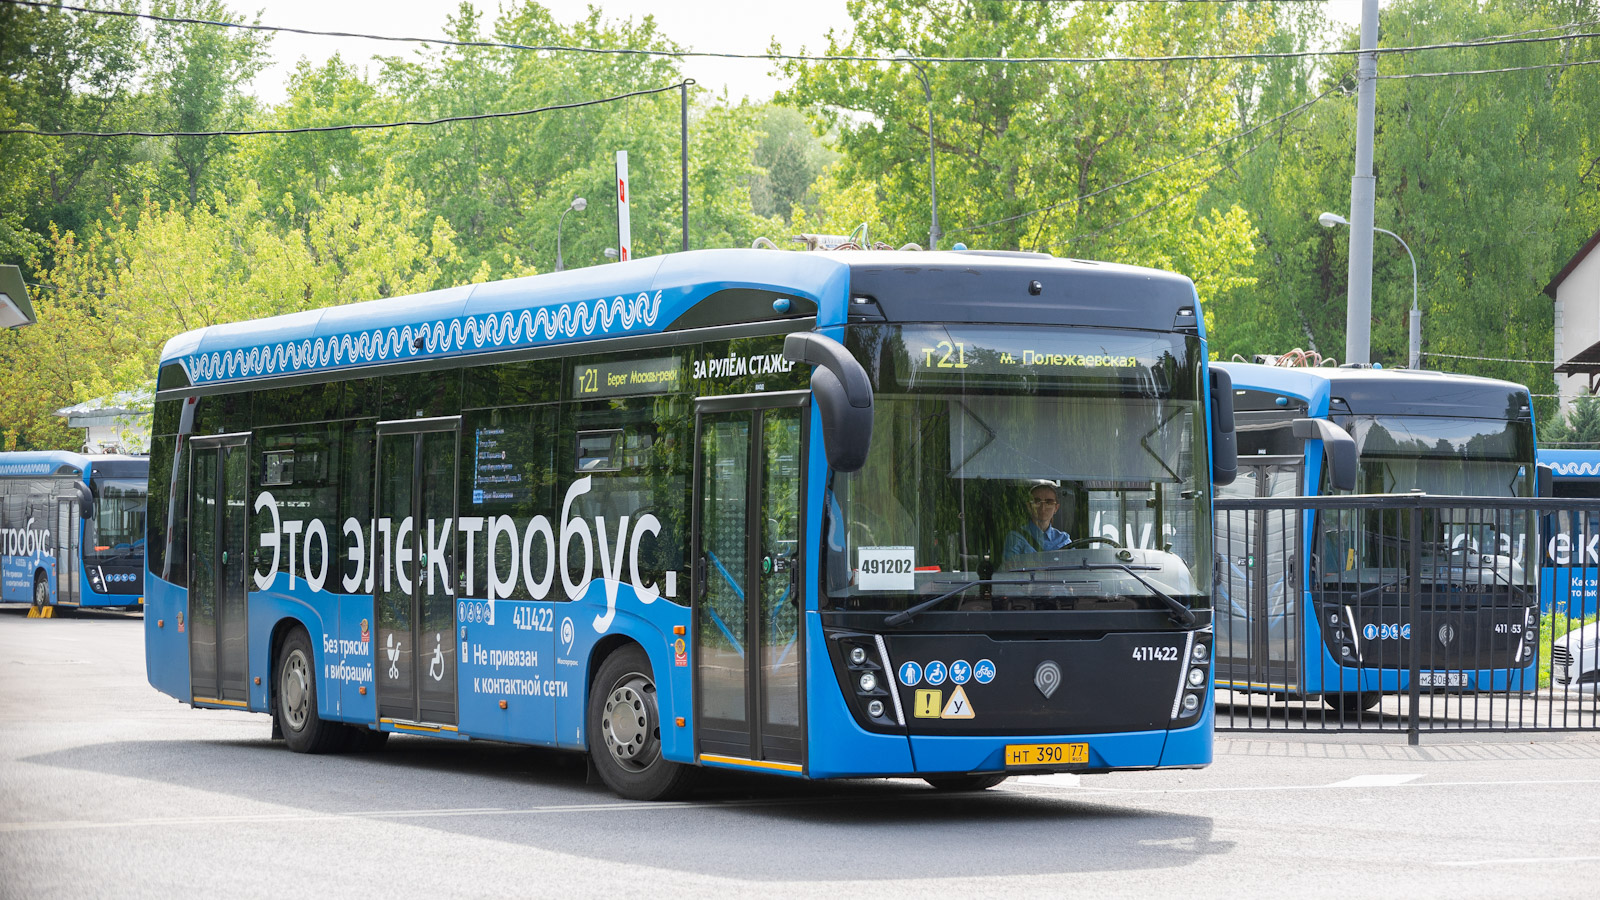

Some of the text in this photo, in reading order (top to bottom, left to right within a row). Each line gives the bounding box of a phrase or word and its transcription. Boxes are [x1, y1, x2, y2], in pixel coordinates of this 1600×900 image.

[693, 360, 707, 379] ЗА
[708, 352, 747, 378] РУЛЁМ
[1022, 350, 1136, 367] Полежаевская
[607, 372, 628, 387] Берег
[630, 369, 678, 384] Москвы-реки
[0, 517, 54, 566] тробус.
[253, 474, 677, 634] Это электробус.
[861, 559, 912, 574] 491202
[513, 606, 553, 632] 411422
[1494, 623, 1522, 633] 41153
[323, 633, 369, 659] Без тряски
[473, 643, 488, 666] Не
[489, 648, 538, 670] привязан
[1132, 646, 1178, 661] 411422
[324, 660, 373, 685] и вибраций
[474, 674, 568, 697] к контактной сети
[1036, 746, 1062, 762] 390
[1070, 744, 1084, 757] 77
